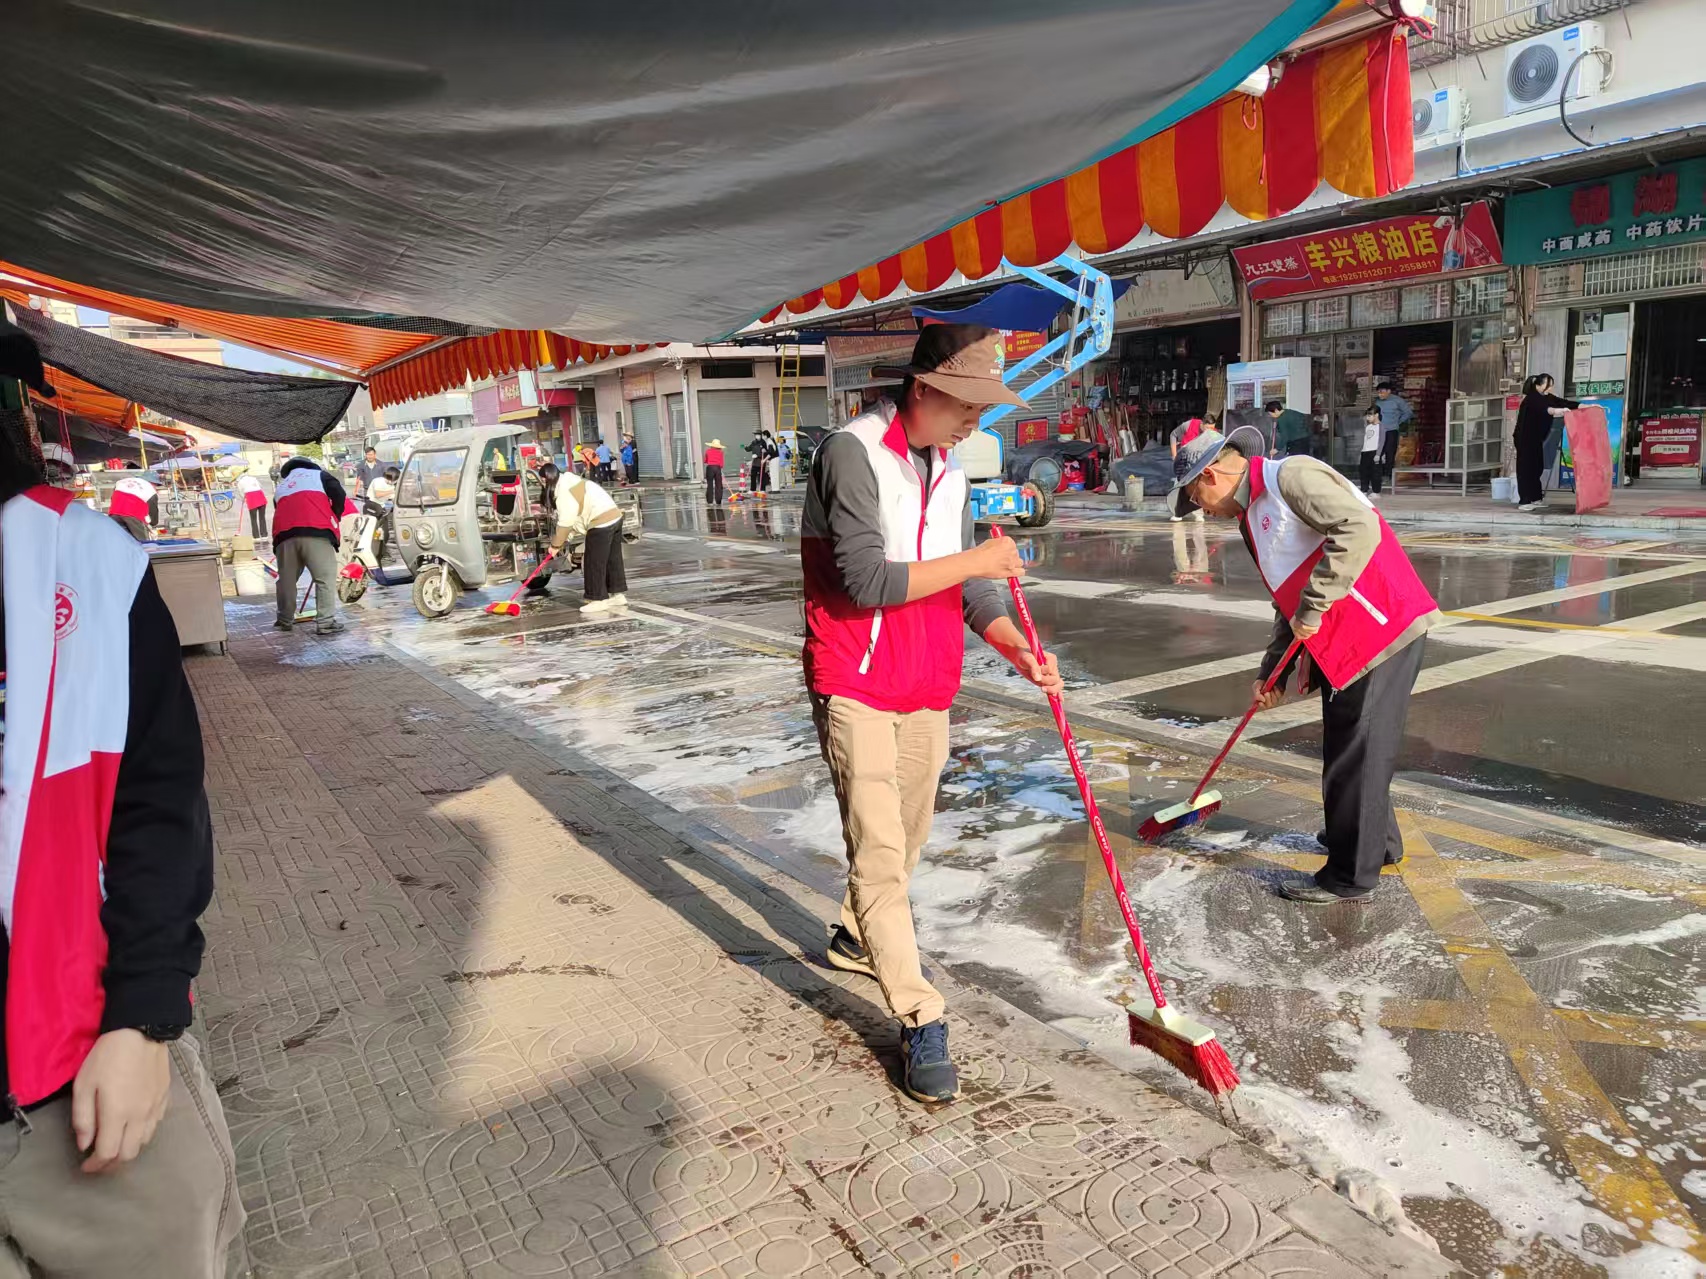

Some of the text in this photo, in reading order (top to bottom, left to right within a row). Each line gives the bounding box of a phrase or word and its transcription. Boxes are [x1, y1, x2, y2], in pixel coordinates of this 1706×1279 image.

[1626, 213, 1706, 240] 中药饮片
[1304, 221, 1438, 272] 丰兴粮油店
